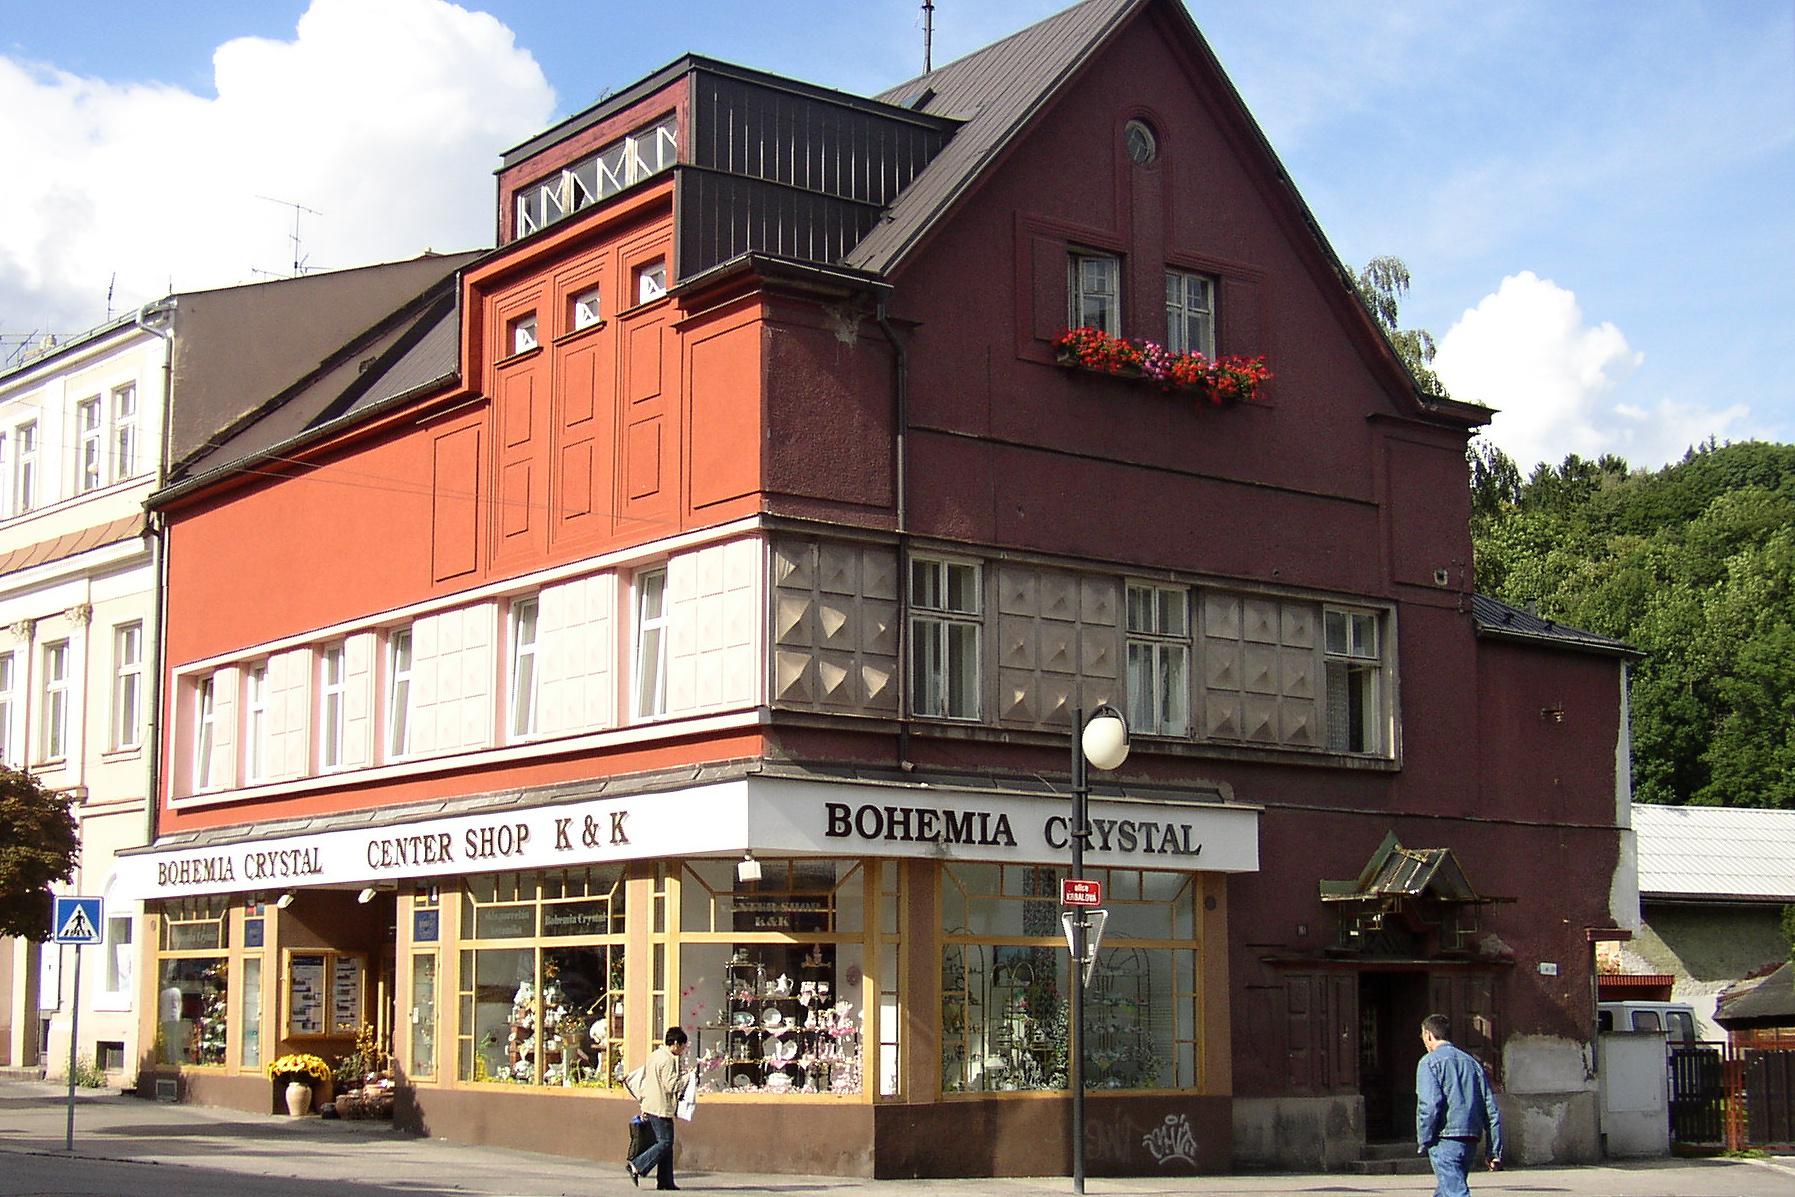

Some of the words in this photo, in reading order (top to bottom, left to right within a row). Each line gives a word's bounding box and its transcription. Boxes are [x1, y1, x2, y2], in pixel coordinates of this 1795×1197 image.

[158, 855, 236, 887] BOHEMIA
[244, 847, 323, 881] CRYSTAL
[367, 832, 453, 869] CENTER
[465, 823, 531, 860] SHOP
[554, 818, 573, 850] K
[582, 814, 600, 848] &
[609, 811, 630, 845] K
[825, 802, 1018, 847] BOHEMIA
